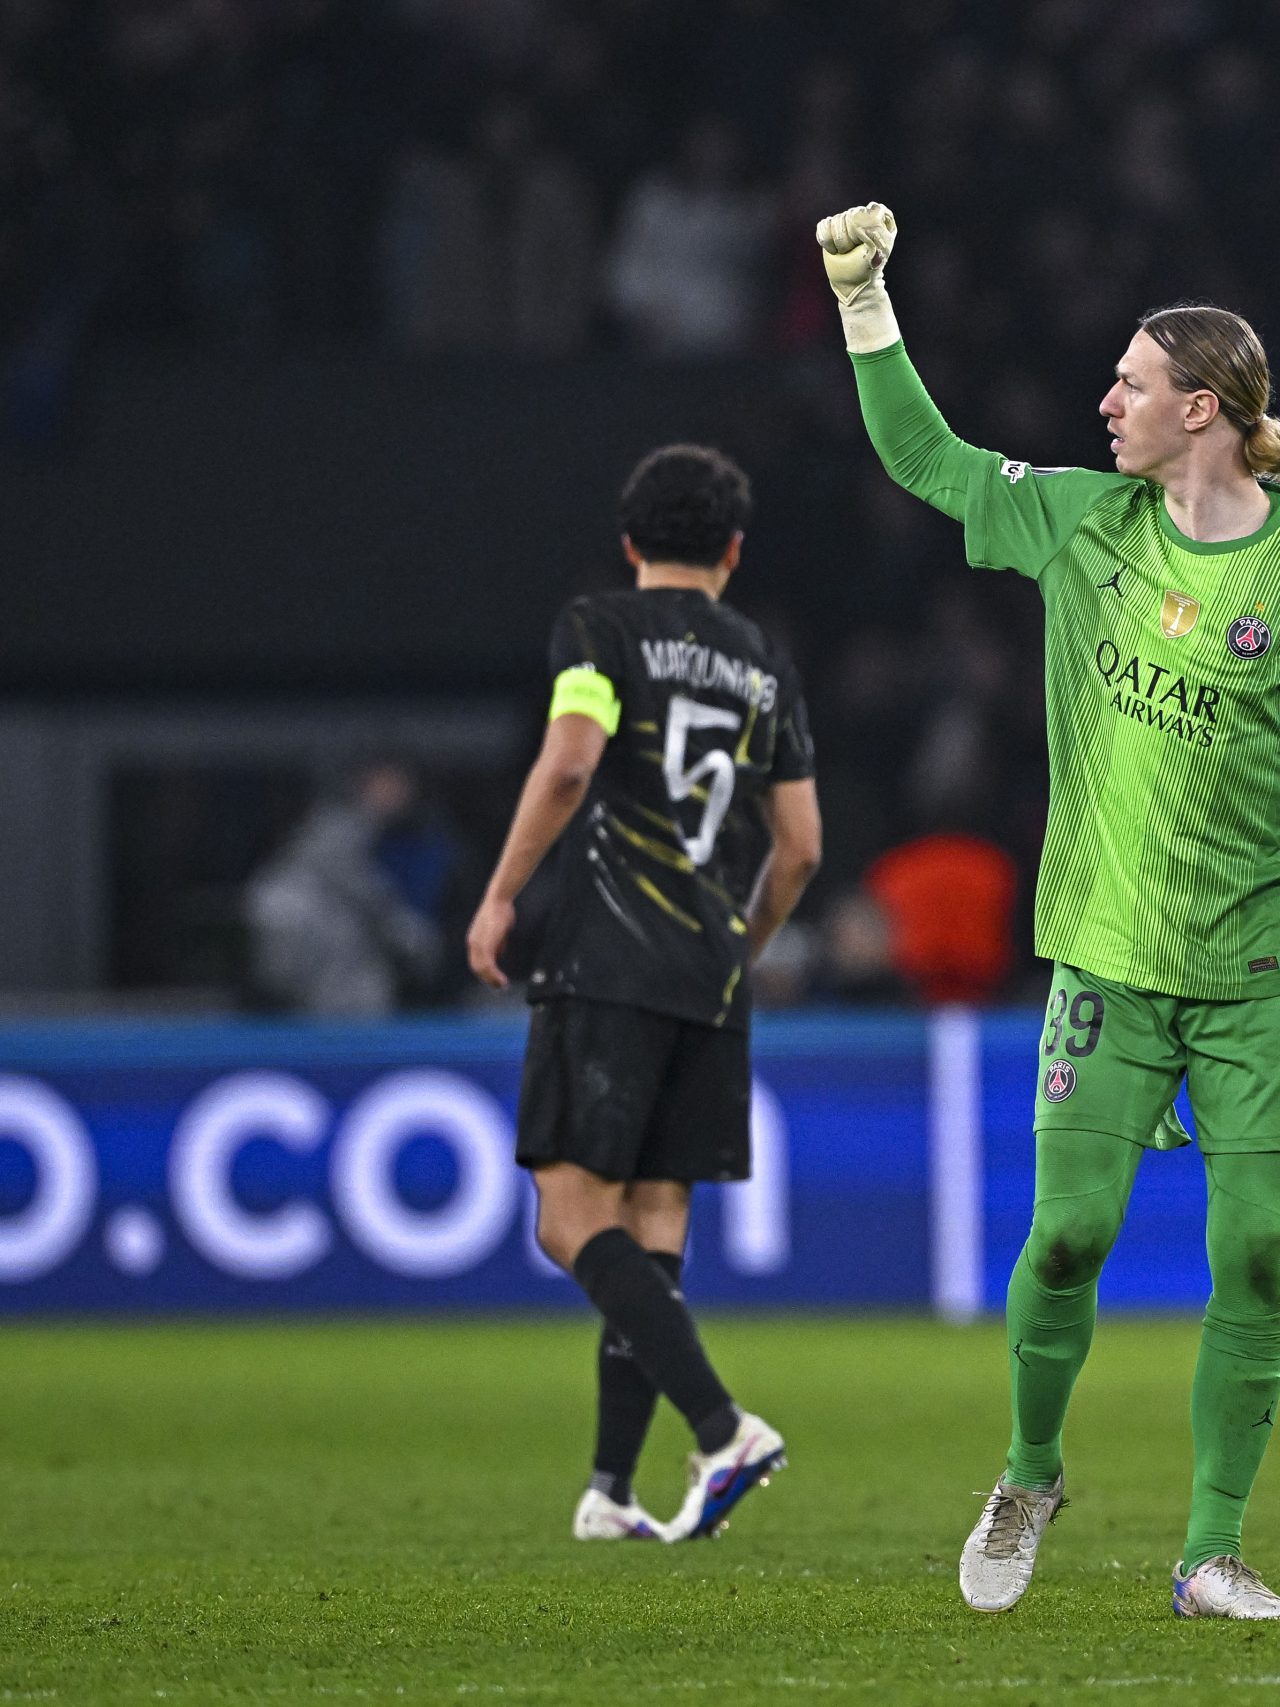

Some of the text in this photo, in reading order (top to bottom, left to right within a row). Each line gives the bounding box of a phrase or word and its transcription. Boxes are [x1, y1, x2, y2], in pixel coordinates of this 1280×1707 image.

[1239, 618, 1267, 634] PARIS
[1096, 640, 1220, 724] QATAR
[1110, 690, 1216, 748] AIRWAYS
[663, 695, 742, 866] 5
[1044, 988, 1105, 1058] 39
[1049, 1062, 1071, 1073] PARIS
